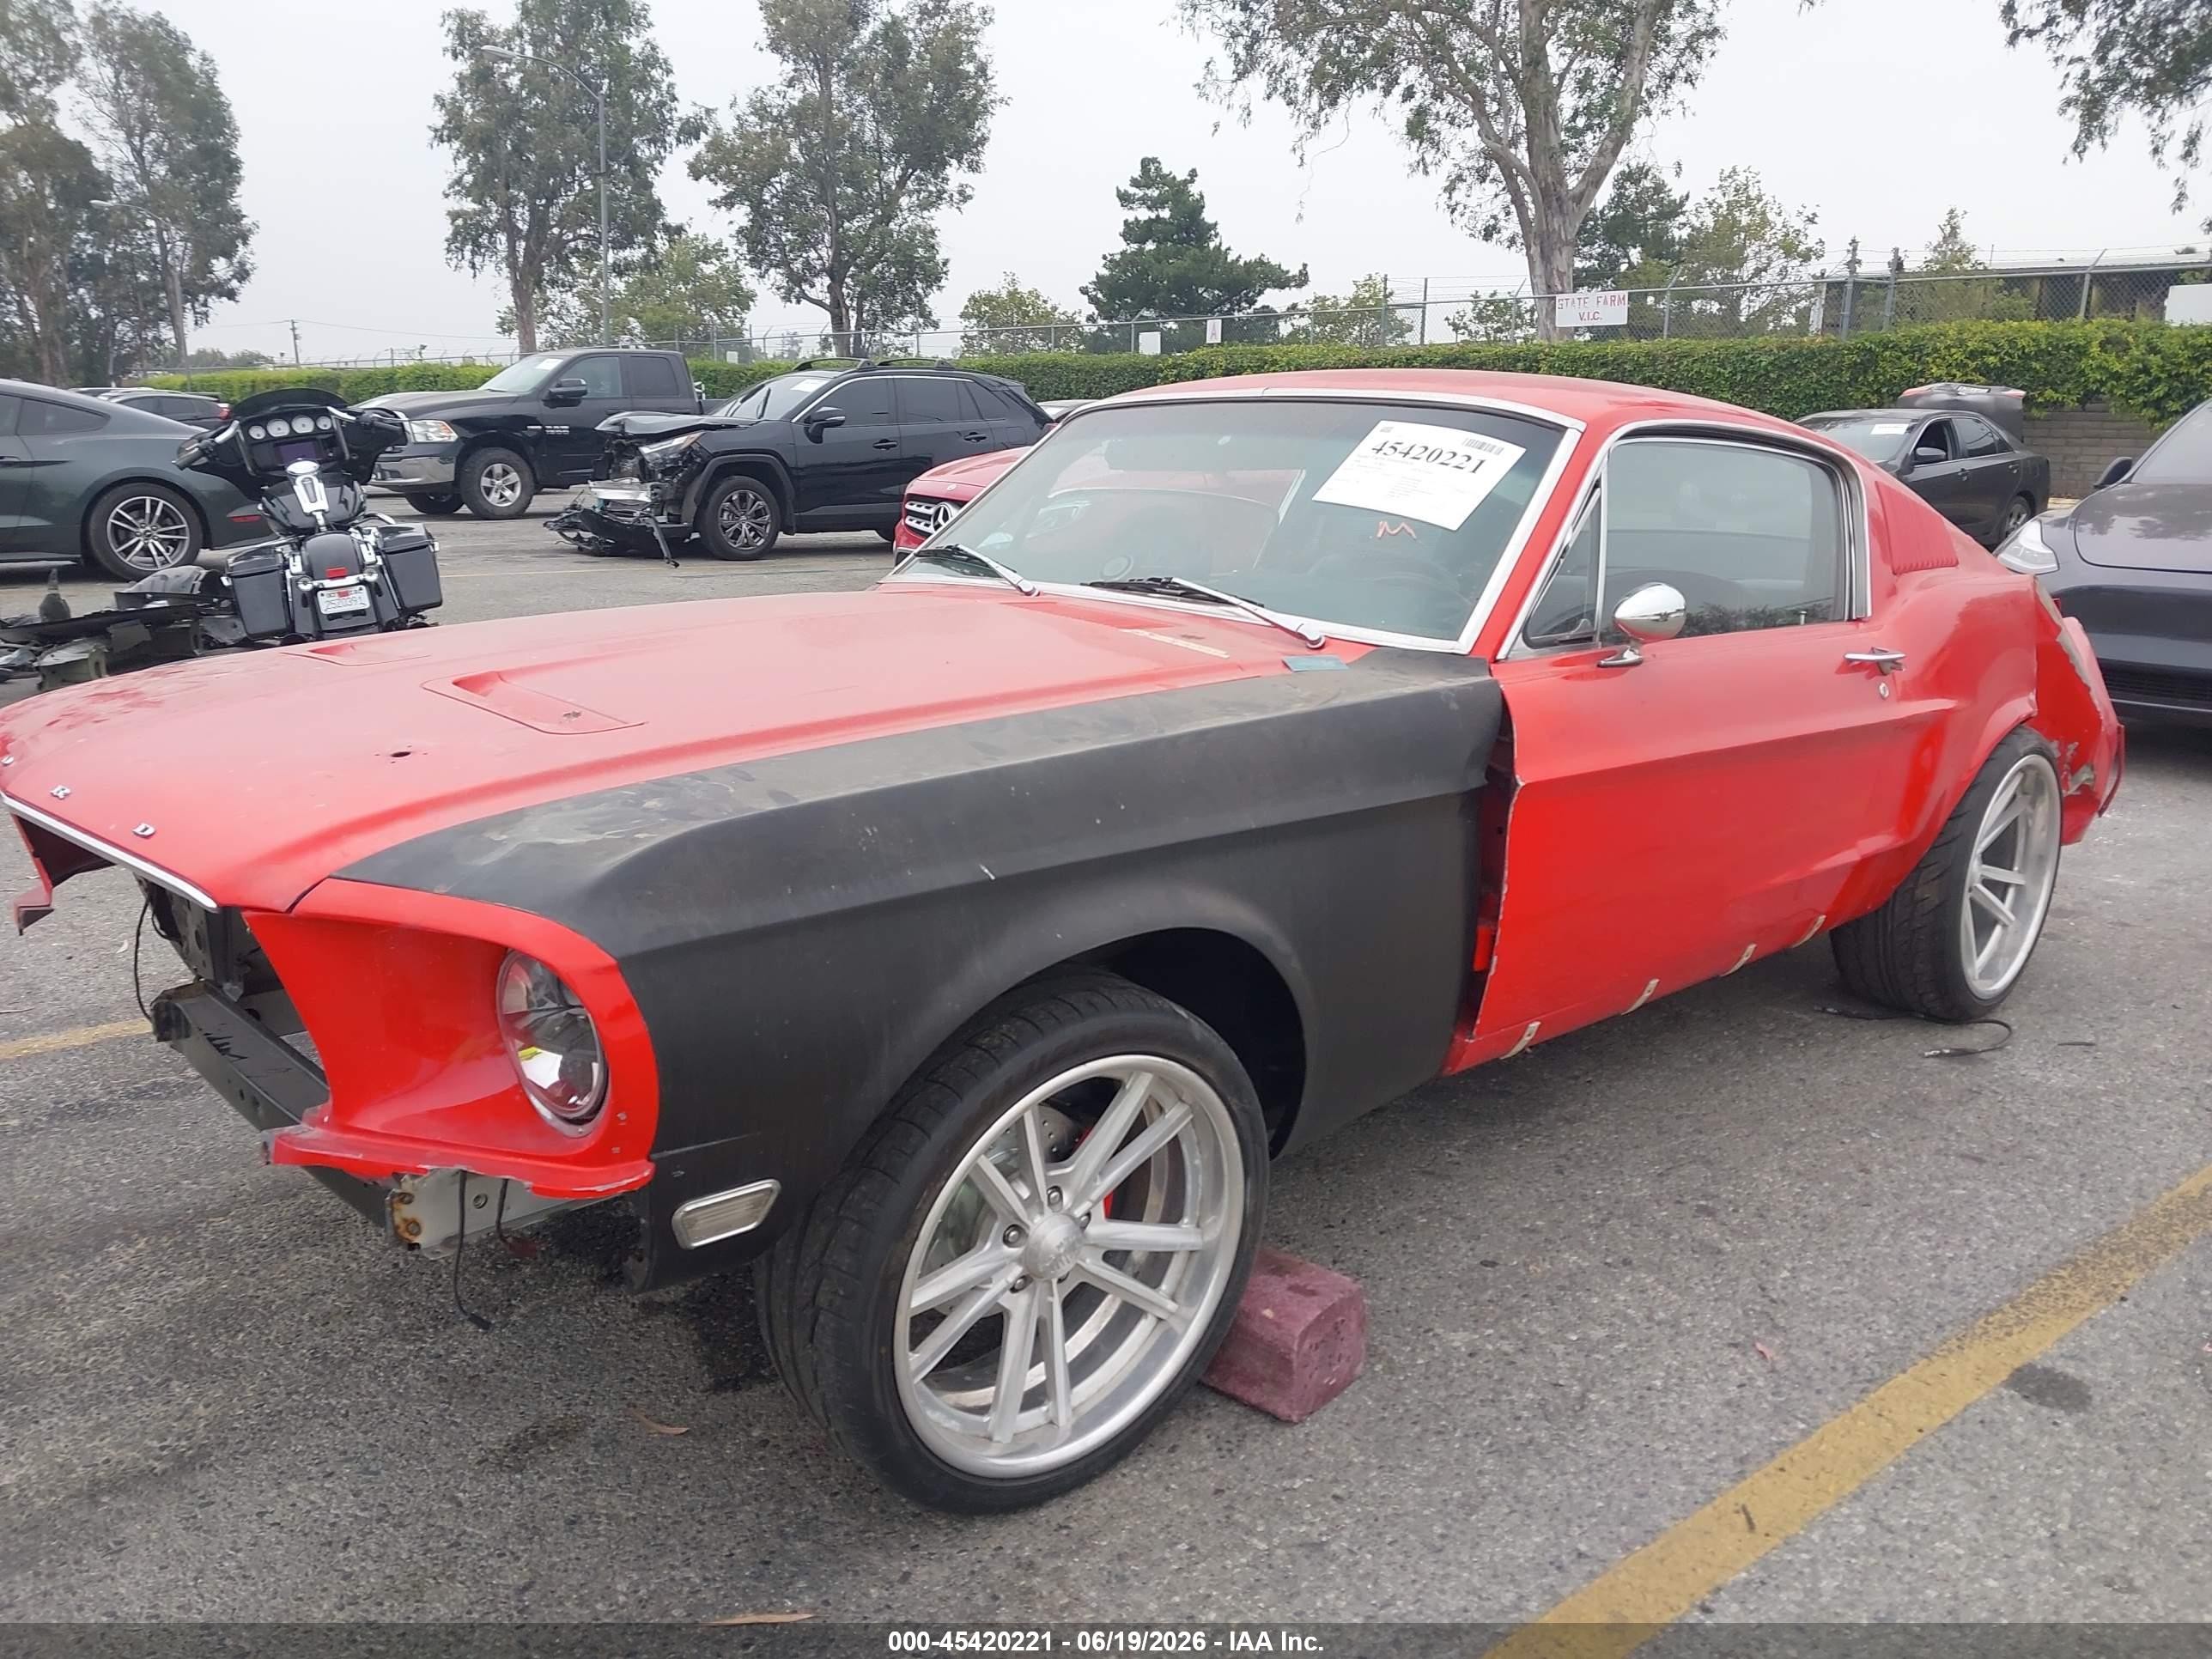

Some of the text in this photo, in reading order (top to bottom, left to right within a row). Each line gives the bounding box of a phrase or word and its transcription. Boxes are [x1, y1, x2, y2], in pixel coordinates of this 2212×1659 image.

[1596, 295, 1626, 307] FARM
[1578, 311, 1603, 322] V.I.C.
[1371, 440, 1486, 474] 45420221
